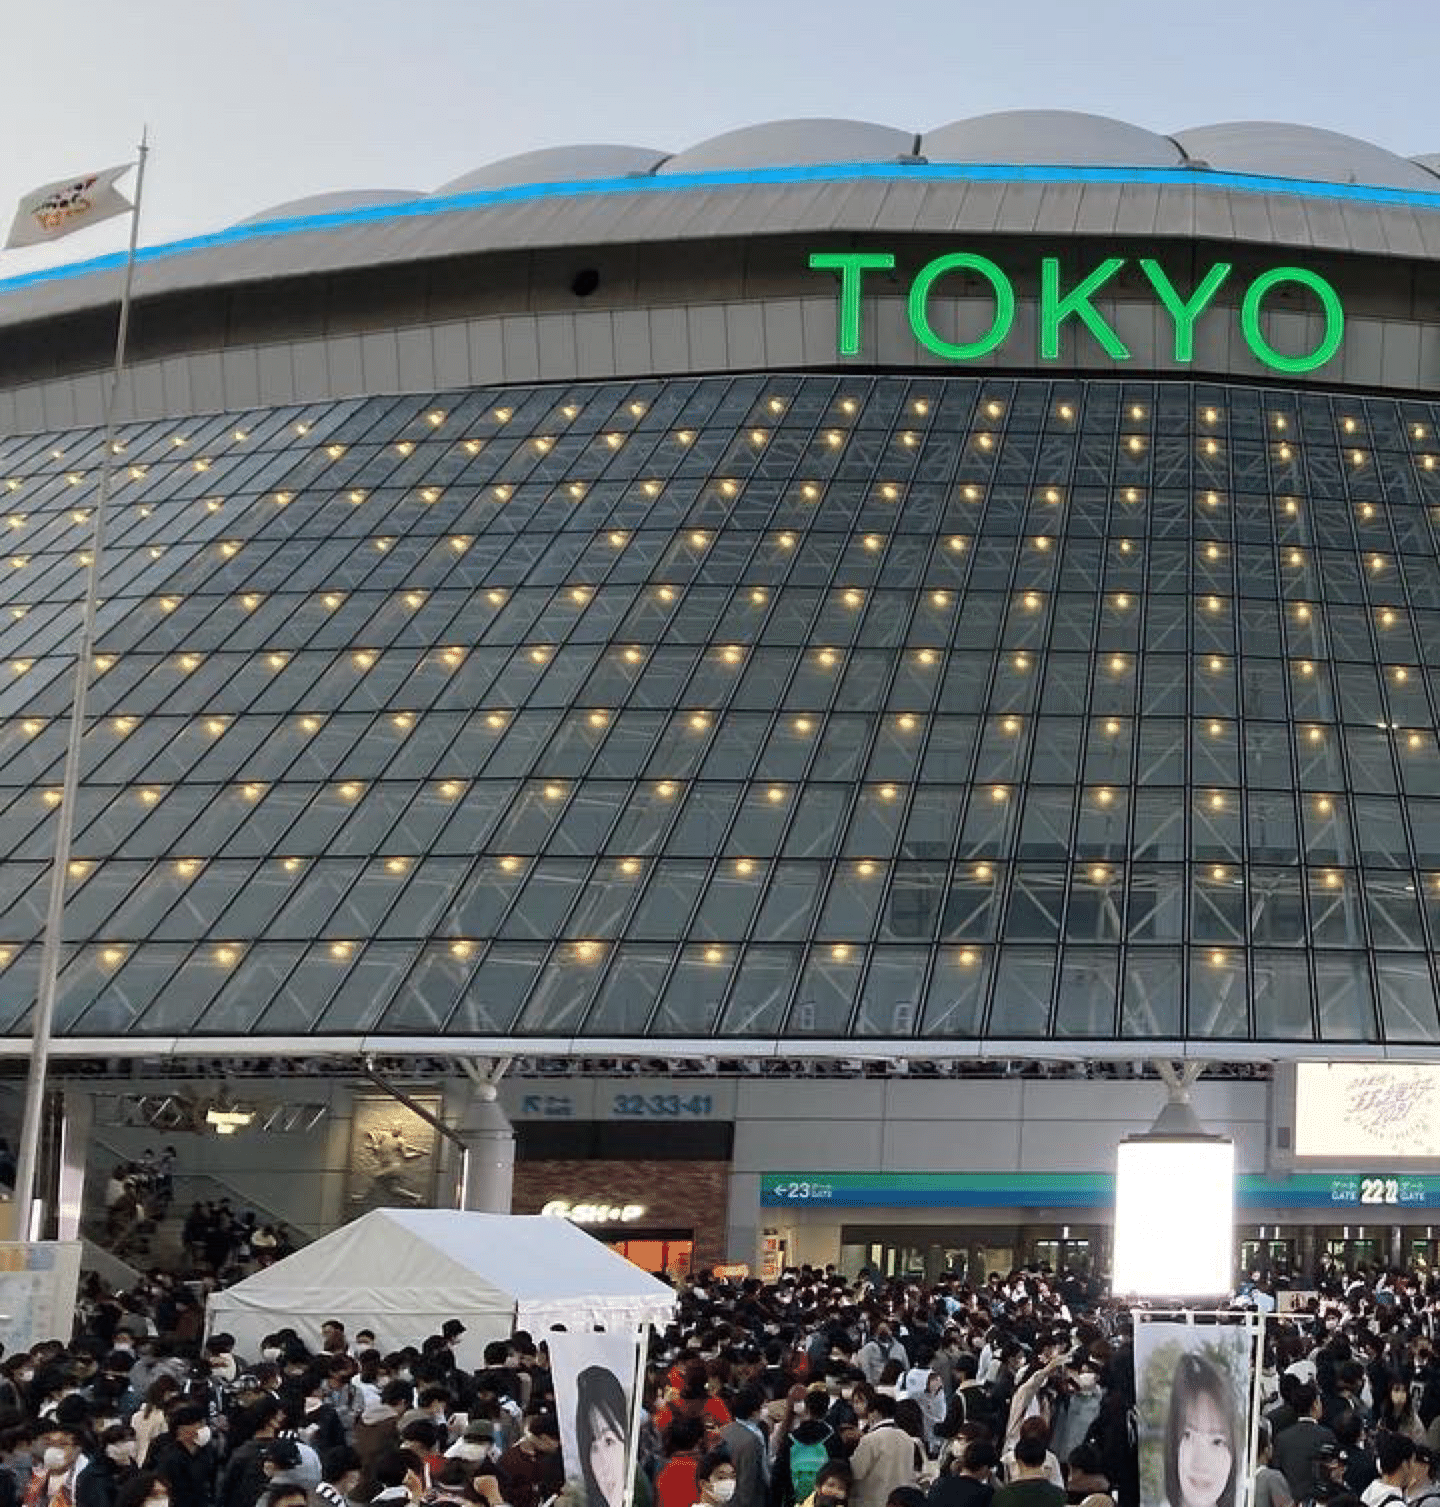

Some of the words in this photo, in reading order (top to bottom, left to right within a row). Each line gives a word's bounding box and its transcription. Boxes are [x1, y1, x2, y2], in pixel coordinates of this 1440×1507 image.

[809, 252, 1344, 372] TOKYO
[788, 1182, 810, 1198] 23
[1361, 1178, 1383, 1204] 22
